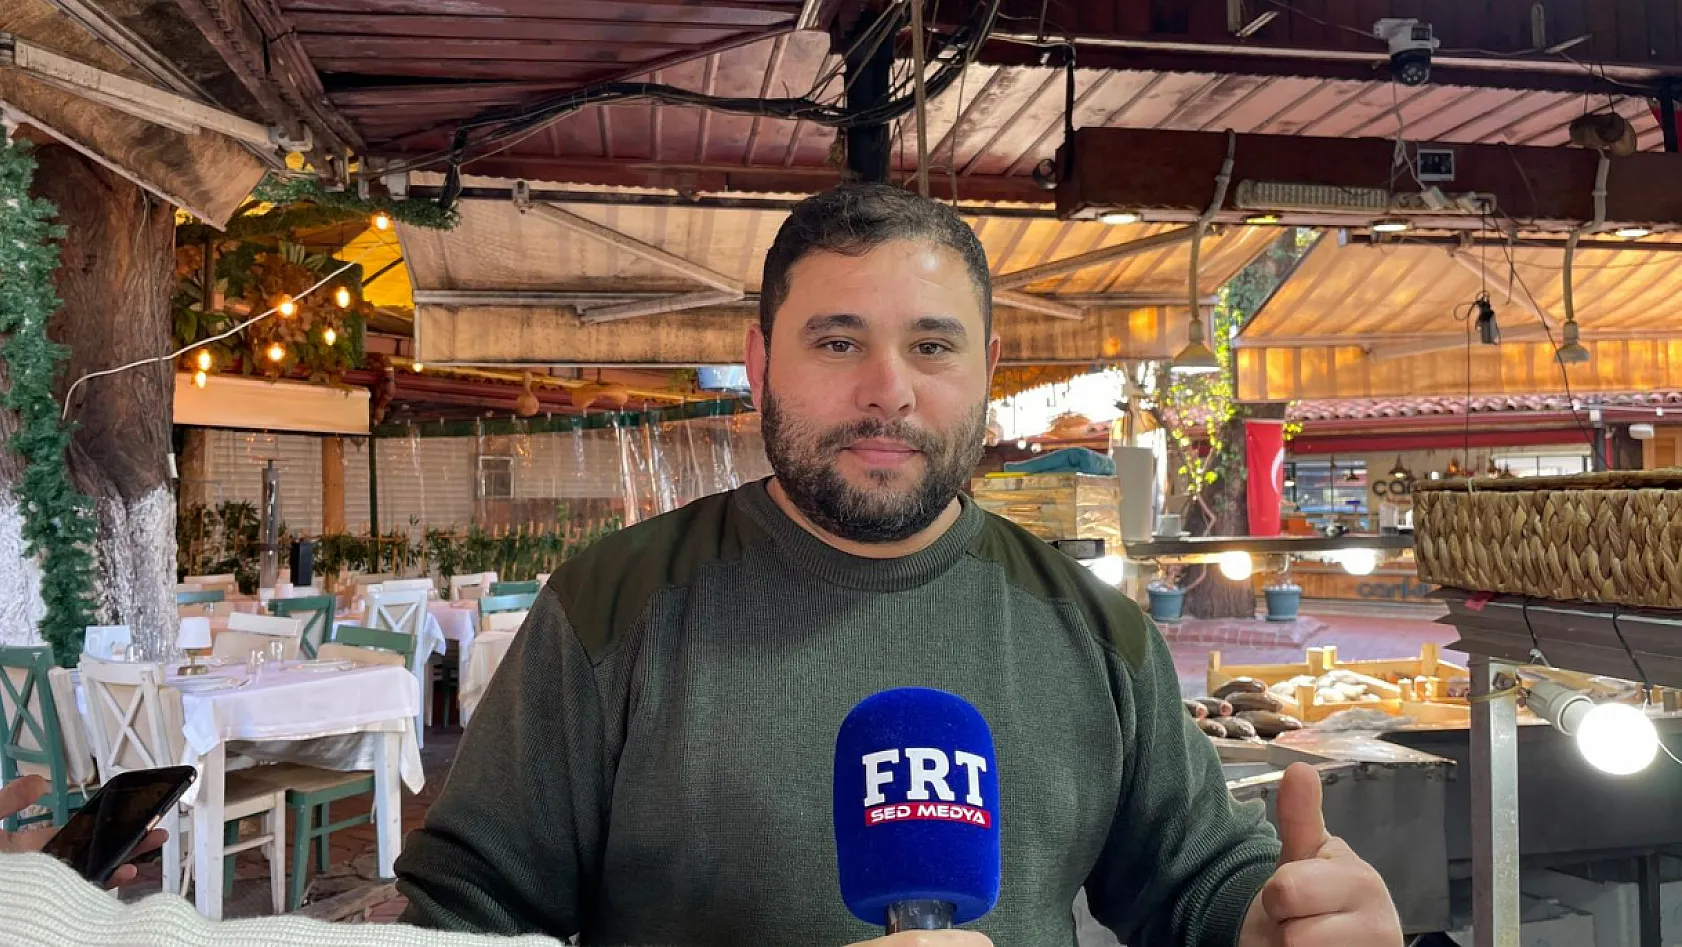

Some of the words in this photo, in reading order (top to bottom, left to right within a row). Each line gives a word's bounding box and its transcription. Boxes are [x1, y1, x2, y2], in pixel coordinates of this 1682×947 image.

[862, 747, 987, 807] FRT
[870, 805, 911, 823] SED
[917, 804, 986, 825] MEDYA
